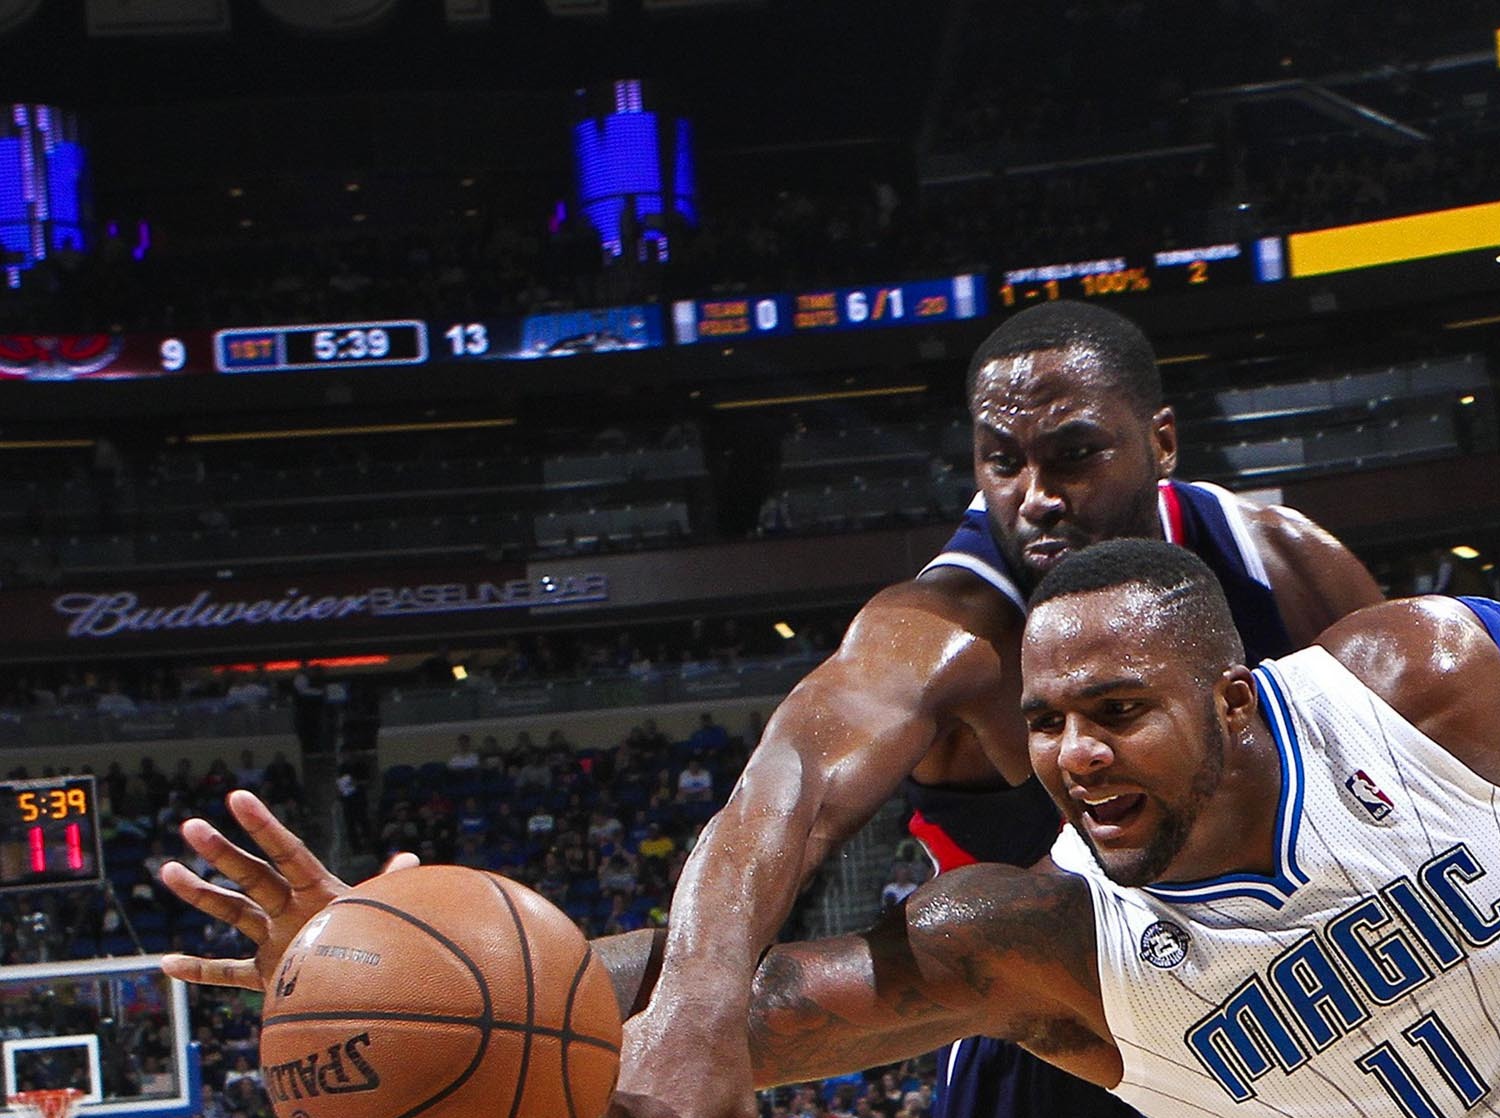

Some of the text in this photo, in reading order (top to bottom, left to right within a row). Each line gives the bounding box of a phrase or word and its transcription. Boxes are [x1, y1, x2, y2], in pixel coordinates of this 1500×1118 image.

[756, 299, 778, 330] 0
[160, 338, 187, 371] 9
[314, 329, 391, 361] 5:39
[445, 322, 490, 356] 13
[54, 590, 369, 638] Budweiser
[18, 788, 87, 822] 5:39
[29, 823, 84, 873] 11
